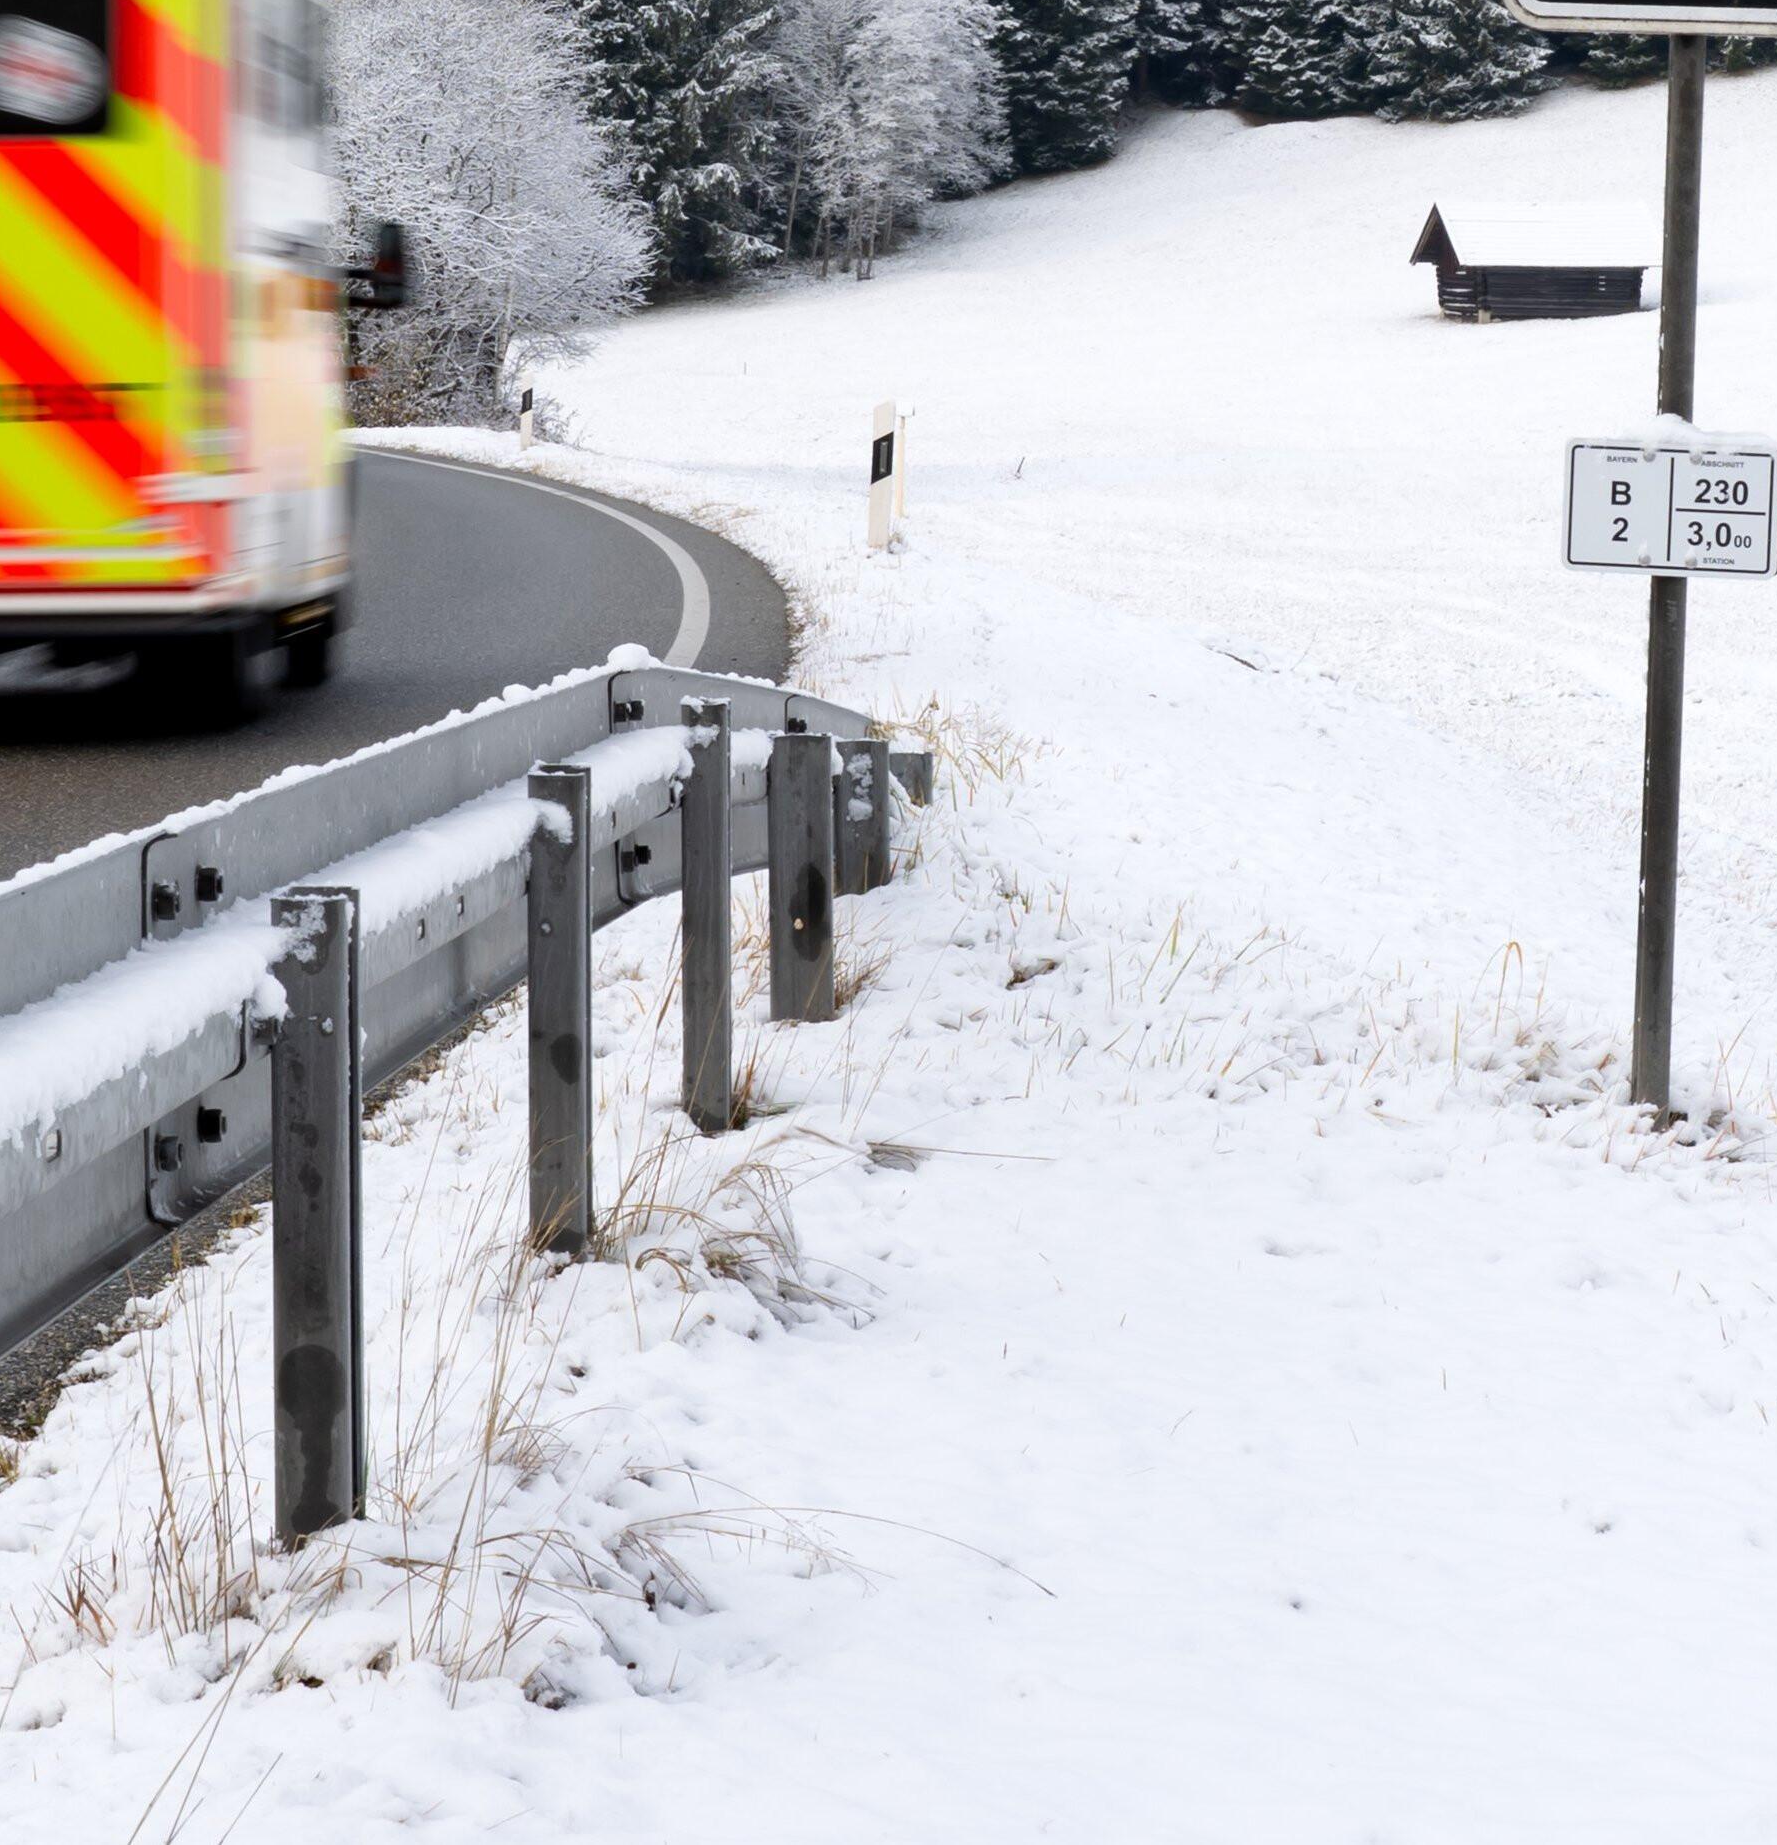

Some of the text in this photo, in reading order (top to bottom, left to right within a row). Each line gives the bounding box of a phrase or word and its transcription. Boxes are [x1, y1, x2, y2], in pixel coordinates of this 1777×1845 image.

[1606, 455, 1638, 464] BAYERN
[1700, 460, 1745, 469] ABSCHNITT
[1610, 480, 1632, 506] B
[1694, 478, 1749, 506] 230
[1611, 516, 1629, 543] 2
[1702, 557, 1735, 566] STATION
